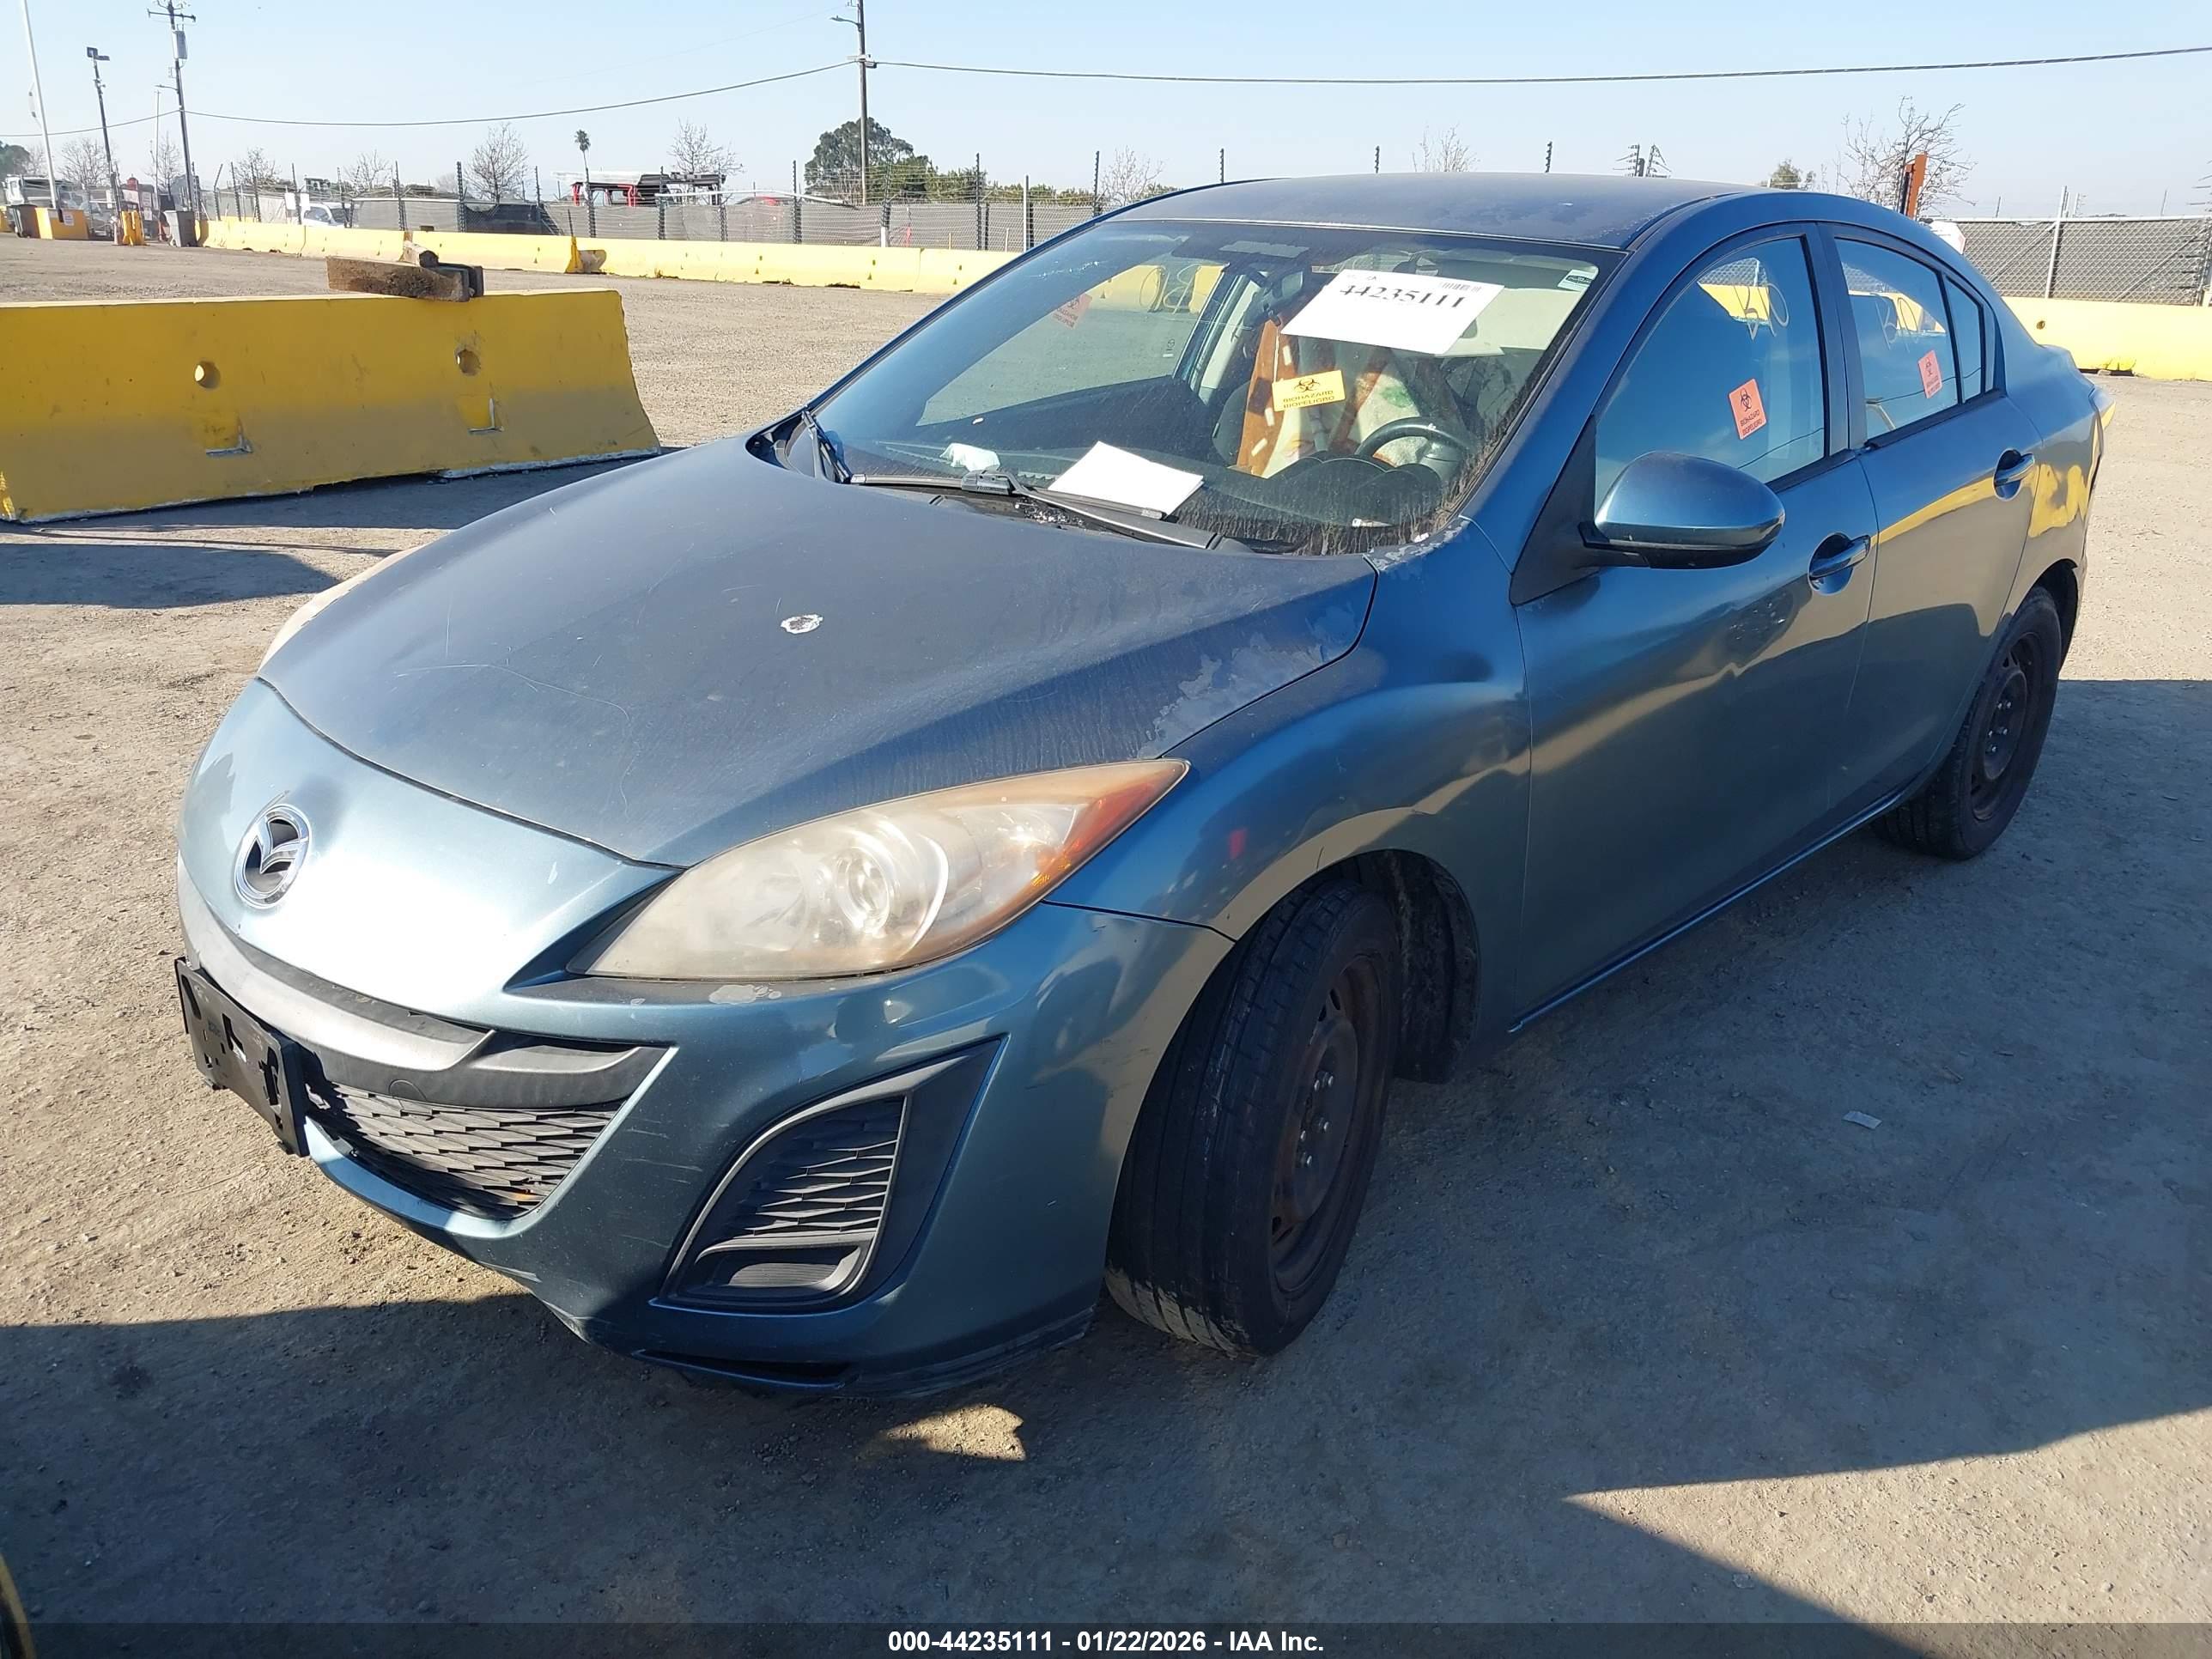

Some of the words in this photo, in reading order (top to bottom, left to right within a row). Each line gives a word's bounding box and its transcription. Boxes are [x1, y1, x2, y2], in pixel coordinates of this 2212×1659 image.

[1340, 284, 1467, 307] 44235111
[1283, 390, 1334, 403] BIOHAZARD
[1283, 396, 1334, 409] BIOPELIGRO
